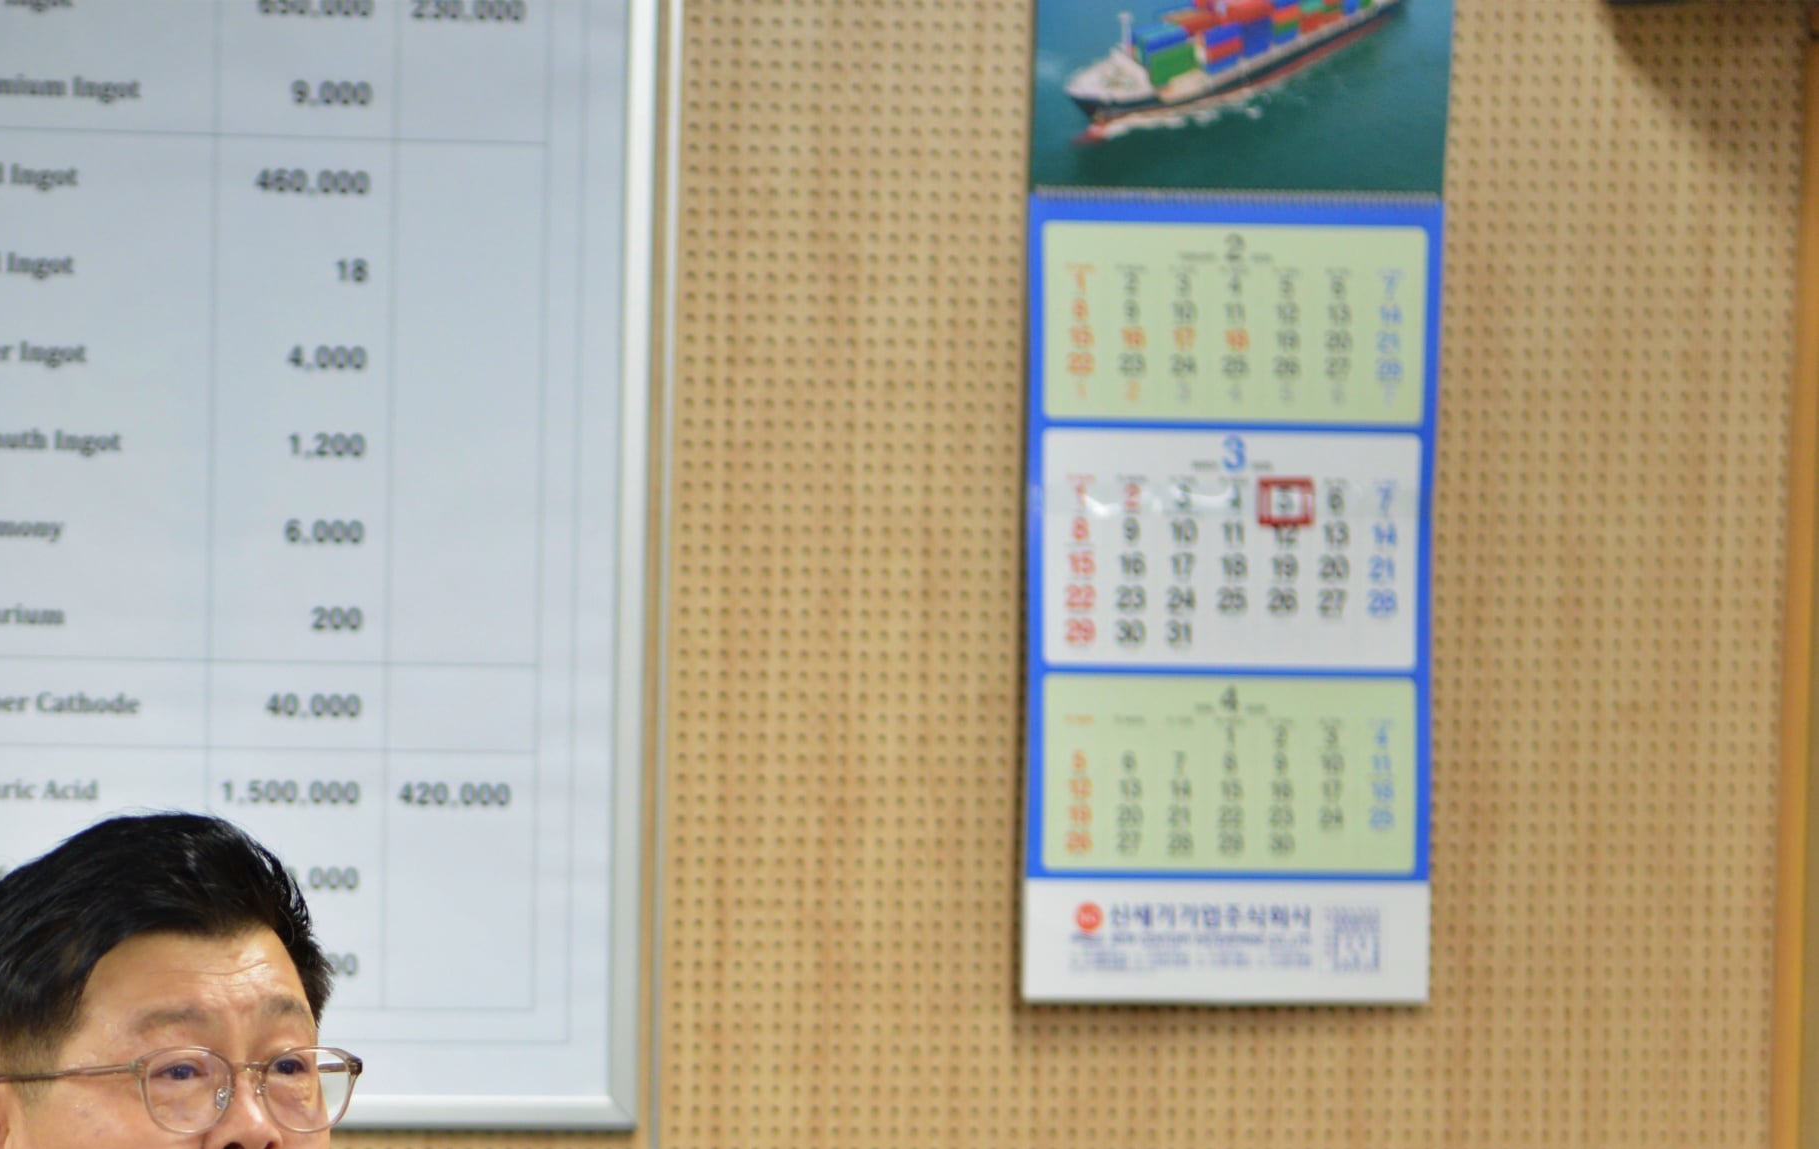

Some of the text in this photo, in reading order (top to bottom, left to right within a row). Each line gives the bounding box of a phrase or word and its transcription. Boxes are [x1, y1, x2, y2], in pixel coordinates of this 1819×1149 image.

[73, 76, 140, 104] Ingot
[10, 163, 78, 192] Ingot
[255, 168, 369, 195] 460,000
[6, 252, 74, 280] Ingot
[337, 259, 368, 283] 18
[19, 341, 86, 369] Ingot
[288, 346, 367, 371] 4,000
[54, 430, 121, 458] Ingot
[289, 432, 366, 458] 1,200
[1222, 434, 1246, 472] 3
[284, 519, 364, 545] 6,000
[1072, 517, 1090, 541] 8
[1123, 518, 1140, 541] 9
[1172, 519, 1198, 543] 10
[1223, 521, 1245, 543] 11
[1325, 521, 1350, 544] 13
[1373, 523, 1398, 545] 14
[1069, 551, 1396, 581] 15 16 17 18 19 20 21
[1065, 585, 1397, 616] 22 23 24 25 26 27 28
[312, 606, 362, 632] 200
[1065, 619, 1193, 644] 29 30 31
[35, 692, 140, 715] Cathode
[266, 693, 361, 718] 40,000
[43, 780, 98, 801] Acid
[222, 780, 361, 806] 1,500,000
[398, 782, 510, 807] 420,000
